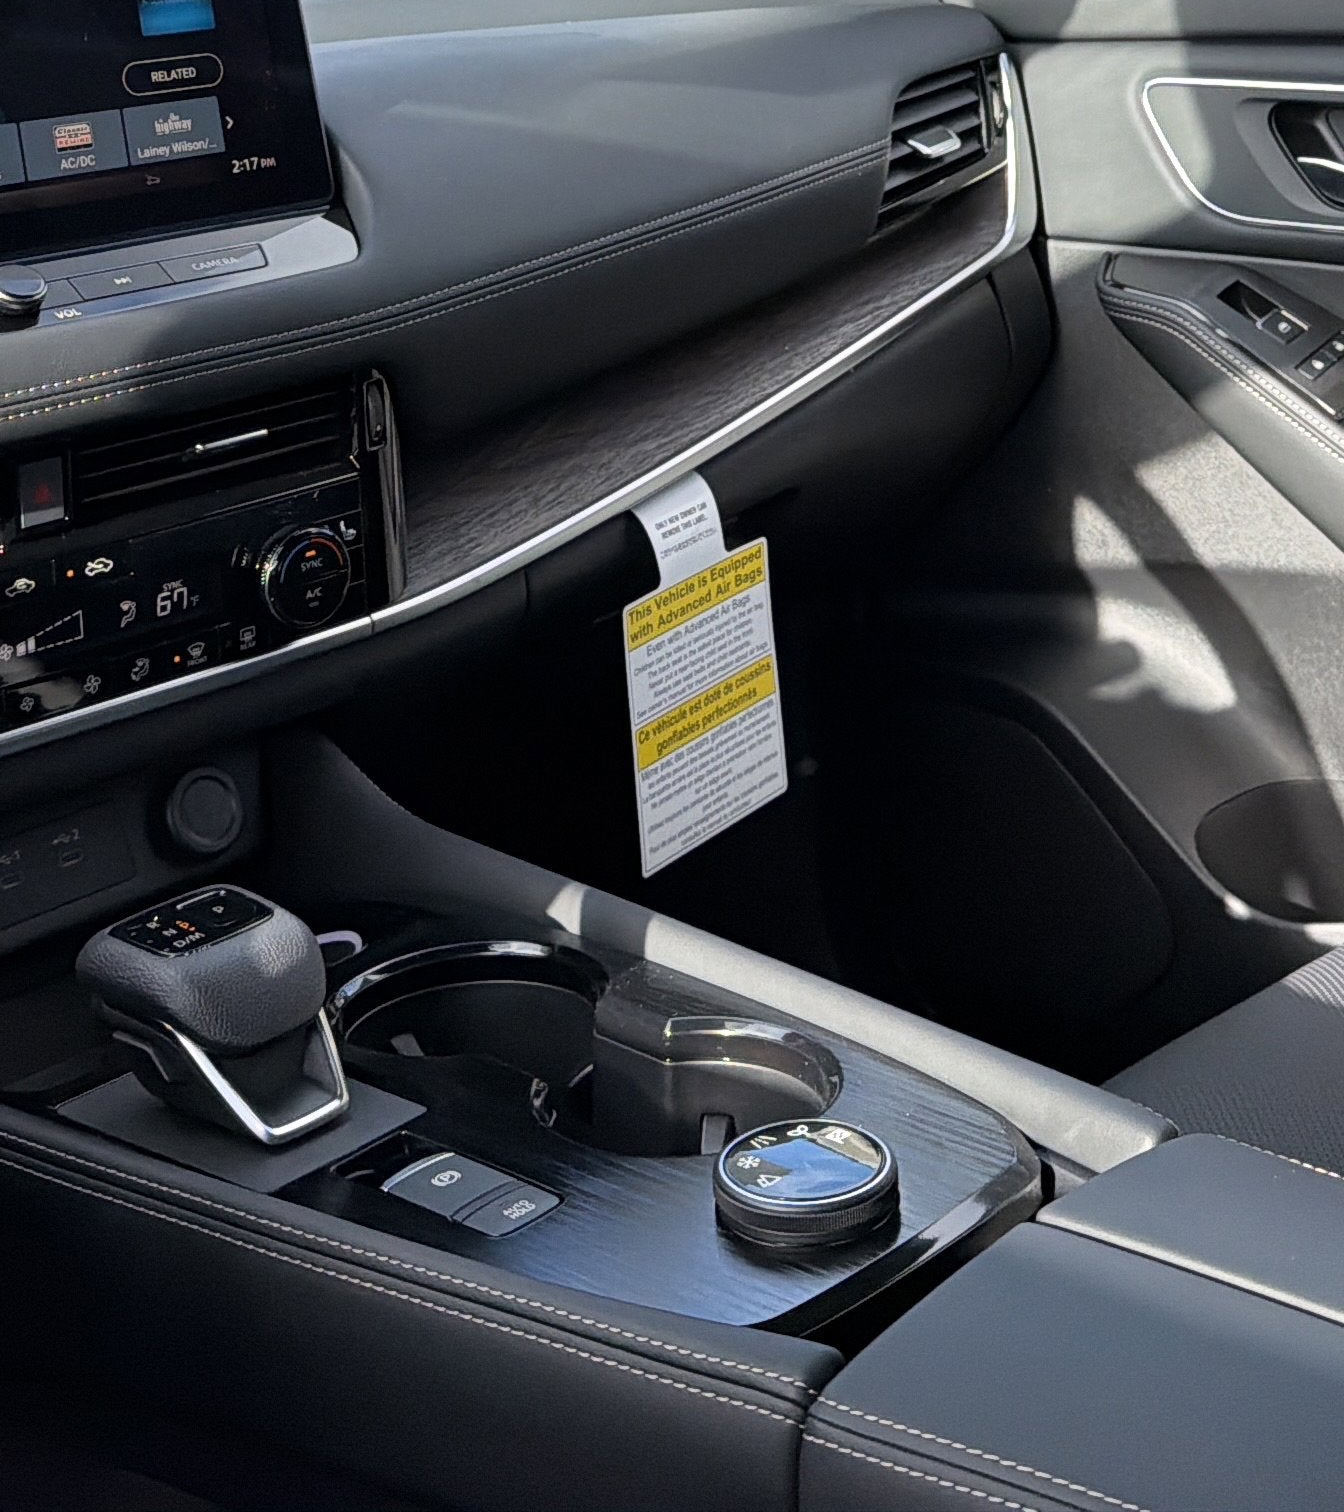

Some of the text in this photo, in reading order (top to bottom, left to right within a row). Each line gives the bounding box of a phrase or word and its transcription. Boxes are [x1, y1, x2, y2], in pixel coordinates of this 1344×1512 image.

[150, 67, 197, 82] RELATED
[154, 118, 192, 135] highway
[137, 146, 170, 160] Lainey
[60, 155, 97, 170] AC/DC
[231, 156, 277, 174] 2:17 PM
[191, 256, 239, 271] CAMERA
[54, 308, 82, 320] VOL
[300, 558, 324, 571] SYNC
[162, 579, 183, 592] SYNC
[628, 547, 762, 625] This Vehicle is Equipped
[305, 587, 322, 600] A/C
[629, 566, 763, 644] with Advanced Air Bags
[646, 594, 751, 657] Even with Advanced Air Bags
[187, 656, 208, 667] FRONT
[638, 729, 650, 744] Ce
[689, 699, 702, 715] est
[722, 682, 733, 695] de
[735, 661, 771, 687] coussins
[173, 932, 206, 948] D/M
[503, 1199, 529, 1216] AUTO
[509, 1203, 536, 1220] HOLD
